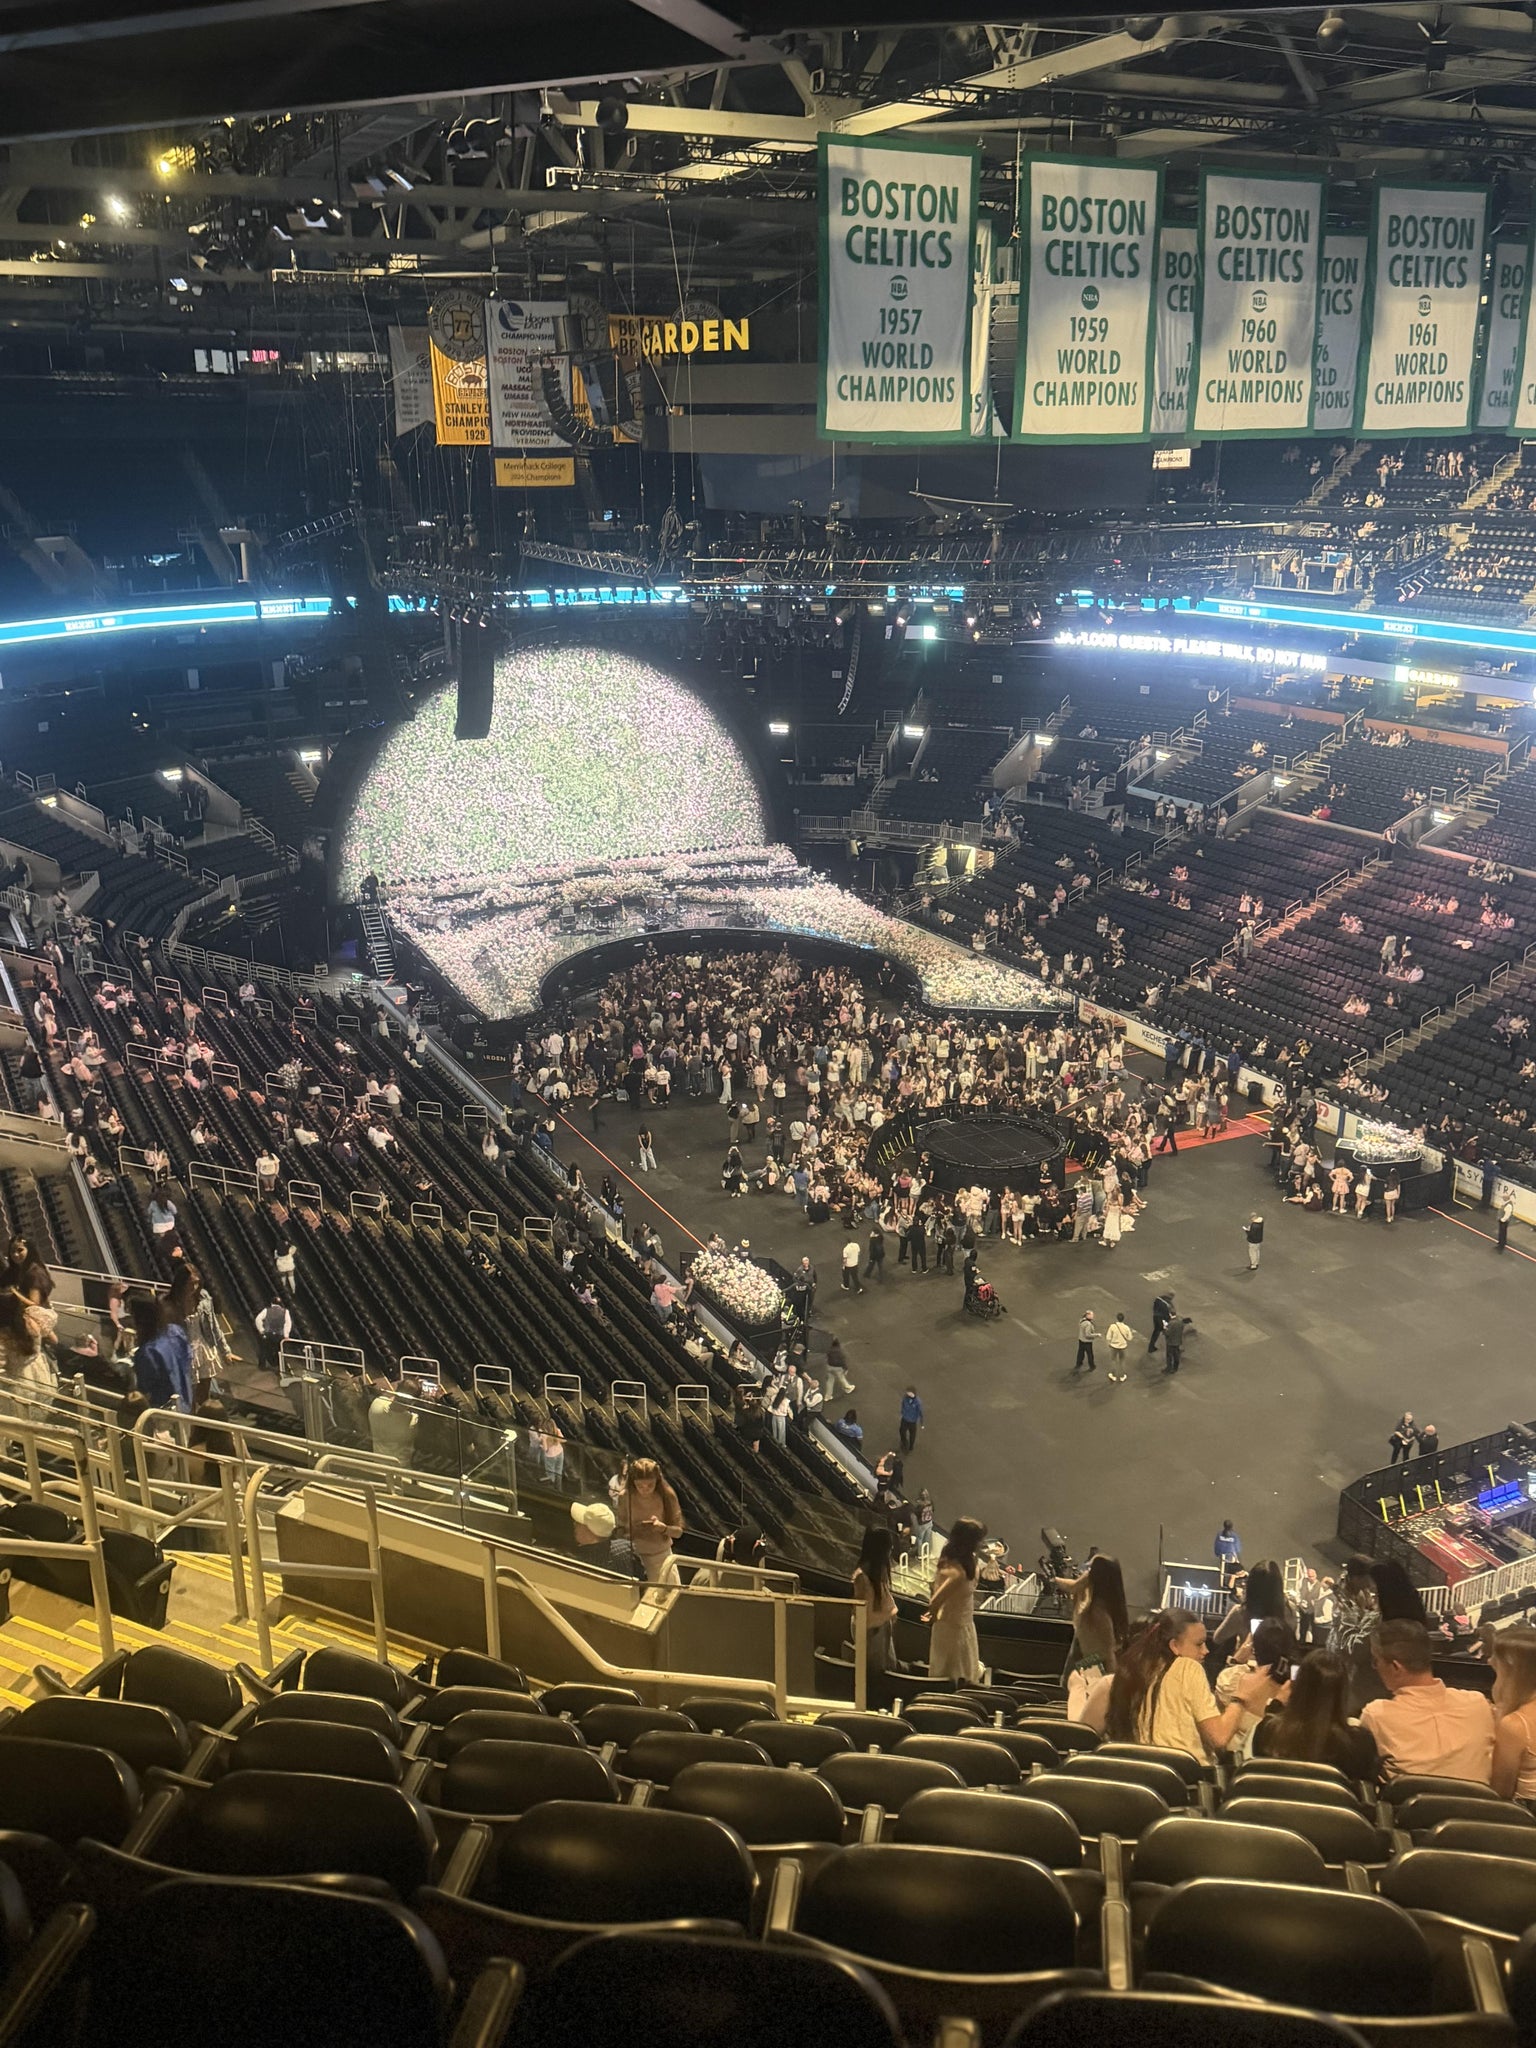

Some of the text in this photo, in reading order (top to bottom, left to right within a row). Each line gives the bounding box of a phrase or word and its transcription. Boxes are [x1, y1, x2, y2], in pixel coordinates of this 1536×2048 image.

[841, 177, 959, 224] BOSTON
[1042, 195, 1146, 236] BOSTON
[1215, 205, 1310, 243] BOSTON
[1387, 214, 1475, 250] BOSTON
[845, 224, 952, 269] CELTICS
[1045, 239, 1140, 278] CELTICS
[1218, 246, 1304, 283] CELTICS
[1322, 257, 1358, 284] TON
[1389, 254, 1468, 289] CELTICS
[890, 282, 909, 294] NBA
[1082, 293, 1099, 302] NBA
[1252, 297, 1267, 307] NBA
[1419, 301, 1431, 310] NBA
[455, 320, 470, 333] 77
[879, 308, 922, 335] 1957
[1070, 317, 1109, 342] 1959
[1241, 319, 1277, 343] 1960
[642, 318, 749, 357] GARDEN
[1409, 323, 1438, 346] 1961
[493, 356, 522, 364] BOSTON
[498, 347, 527, 355] BOSTON
[862, 341, 934, 369] WORLD
[1057, 349, 1121, 375] WORLD
[1228, 349, 1287, 374] WORLD
[446, 361, 487, 387] BOSTO
[1395, 352, 1448, 376] WORLD
[837, 374, 955, 402] CHAMPIONS
[1316, 367, 1337, 387] RLD
[1033, 381, 1138, 406] CHAMPIONS
[1205, 380, 1304, 404] CHAMPIONS
[1315, 390, 1350, 409] PIONS
[1374, 380, 1465, 405] CHAMPIONS
[445, 403, 482, 414] STANLEY
[445, 416, 489, 427] CHAMPIO
[465, 430, 486, 440] 1929
[540, 462, 567, 471] College
[1173, 638, 1221, 656] PLEASE
[1256, 647, 1274, 663] DO
[1275, 649, 1299, 667] NOT
[1408, 669, 1459, 688] GARDEN
